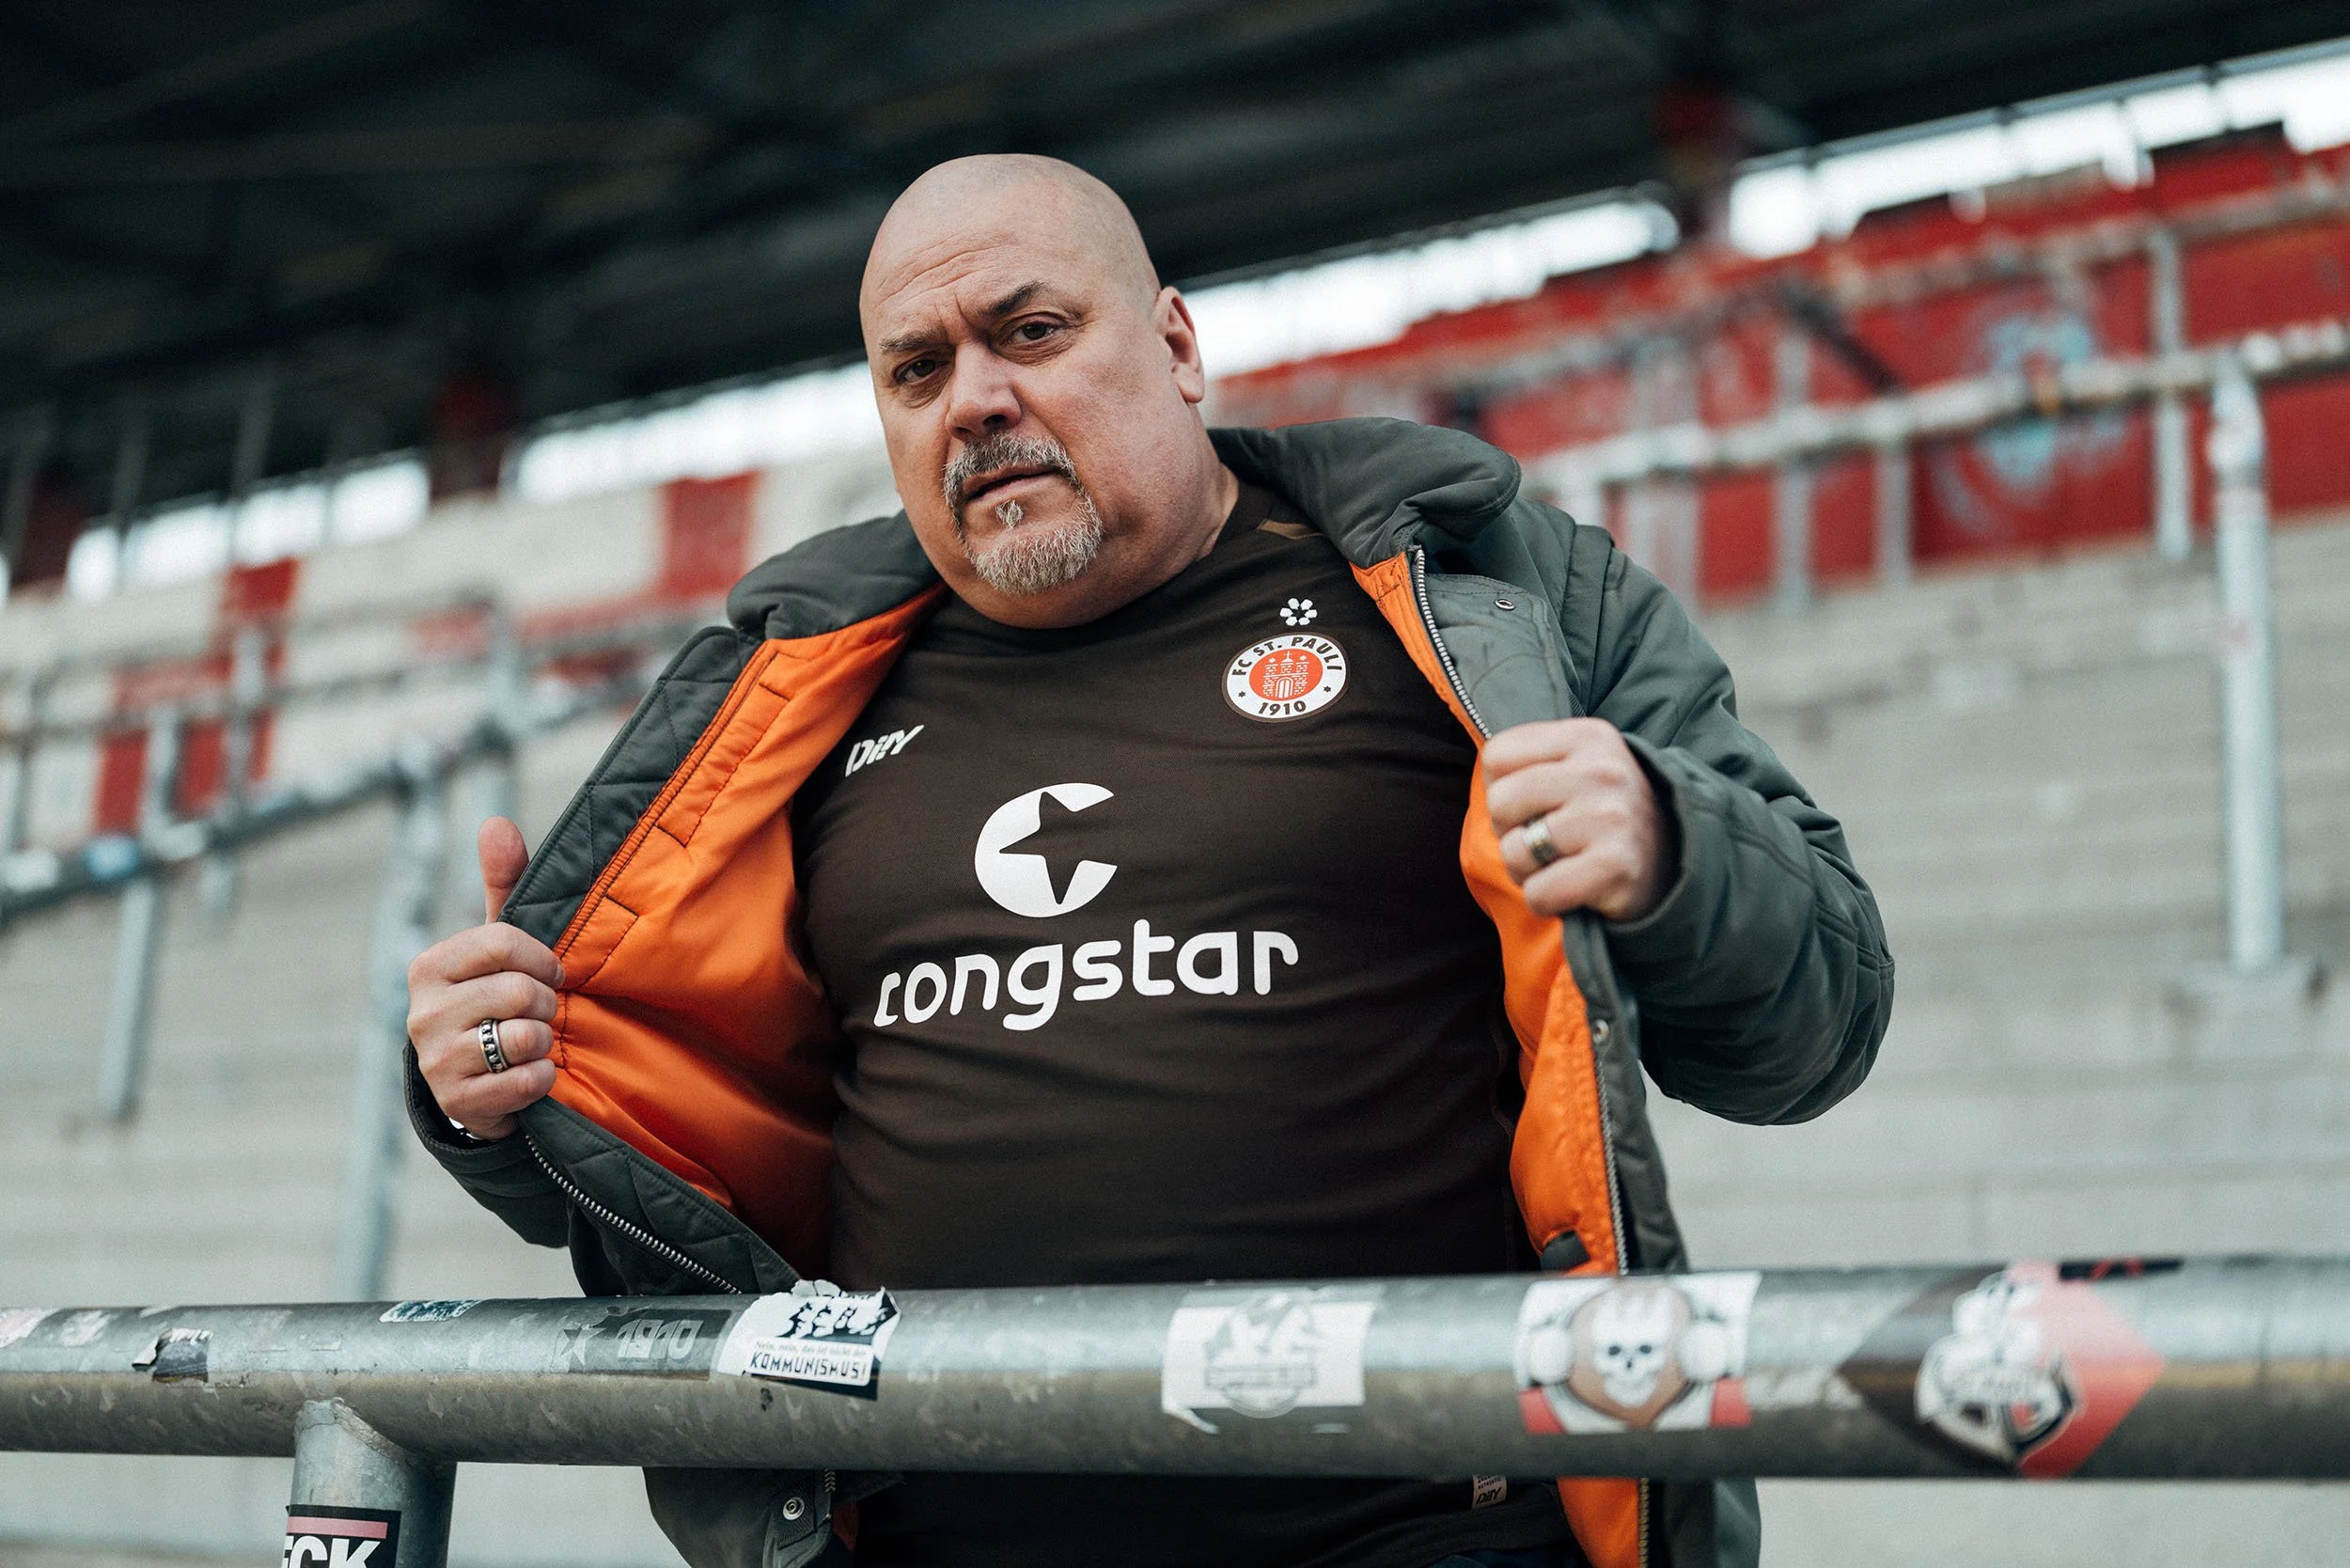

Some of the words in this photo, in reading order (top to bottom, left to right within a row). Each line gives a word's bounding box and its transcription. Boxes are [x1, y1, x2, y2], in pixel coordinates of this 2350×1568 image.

[1231, 659, 1253, 676] FC
[1253, 641, 1282, 656] ST.
[1291, 636, 1342, 670] PAULI
[1258, 700, 1307, 715] 1910
[873, 918, 1299, 1031] congstar
[616, 1319, 704, 1359] 1910
